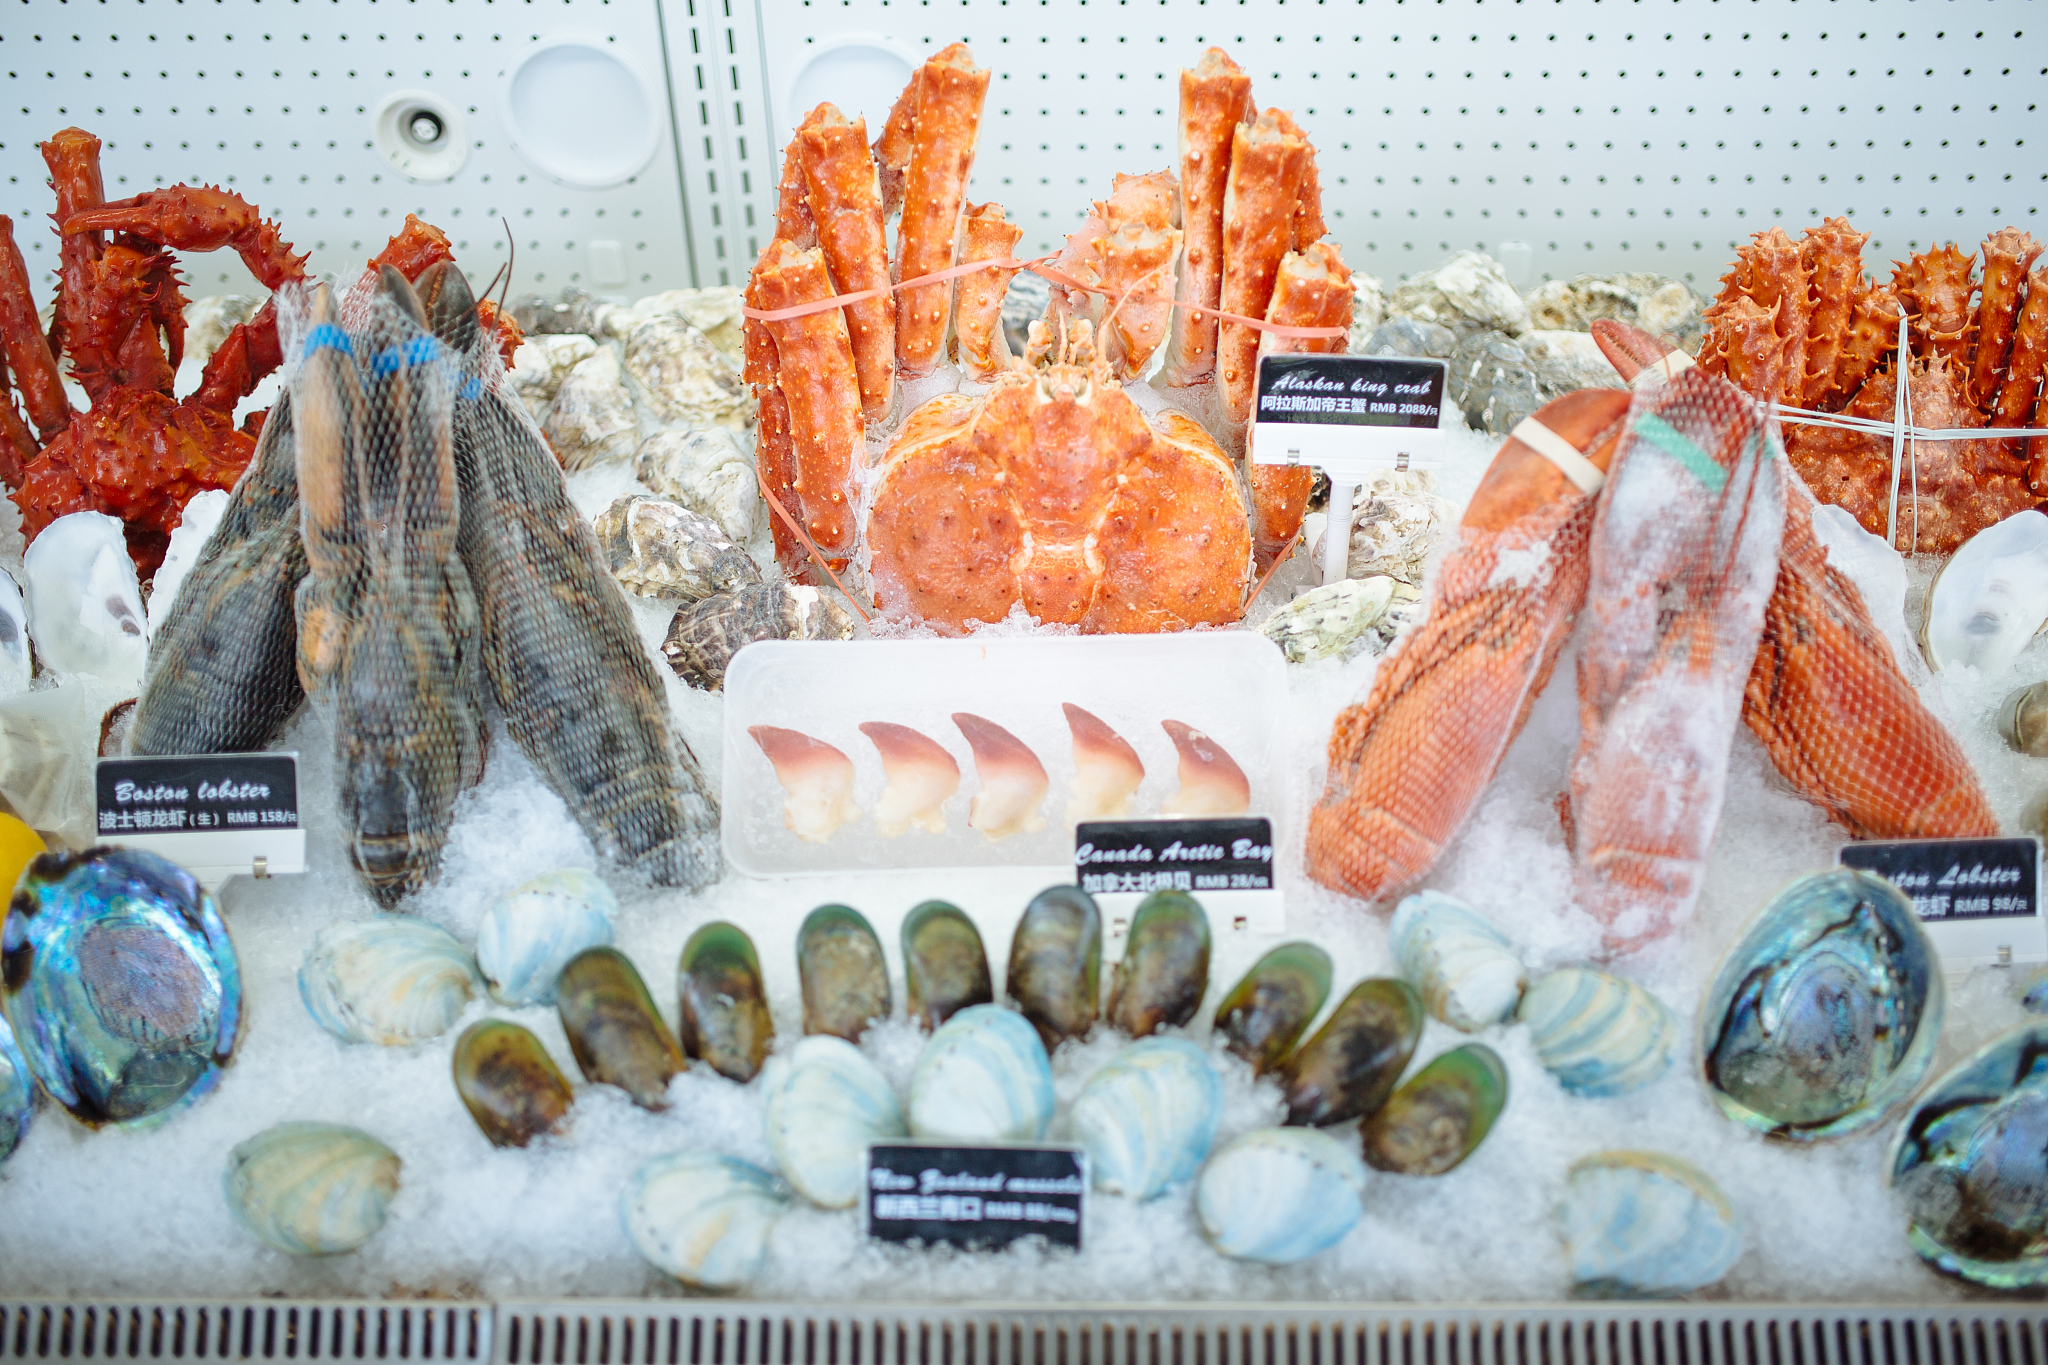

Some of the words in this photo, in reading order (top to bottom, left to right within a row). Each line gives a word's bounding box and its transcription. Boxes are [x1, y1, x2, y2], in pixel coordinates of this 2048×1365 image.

[1271, 375, 1345, 391] Alaskan
[1350, 377, 1388, 396] king
[1394, 380, 1432, 395] crab
[1261, 395, 1367, 413] 阿拉斯加帝王蟹
[1370, 403, 1396, 413] RMB
[115, 781, 190, 802] Boston
[197, 777, 270, 800] lobster
[227, 811, 258, 824] RMB
[1075, 842, 1154, 866] Canada
[1158, 840, 1226, 863] Arctic
[1231, 838, 1273, 863] Bay
[1195, 874, 1229, 889] RMB
[1887, 870, 1930, 888] ston
[1937, 861, 2021, 886] Lobster
[1955, 897, 1990, 912] RMB
